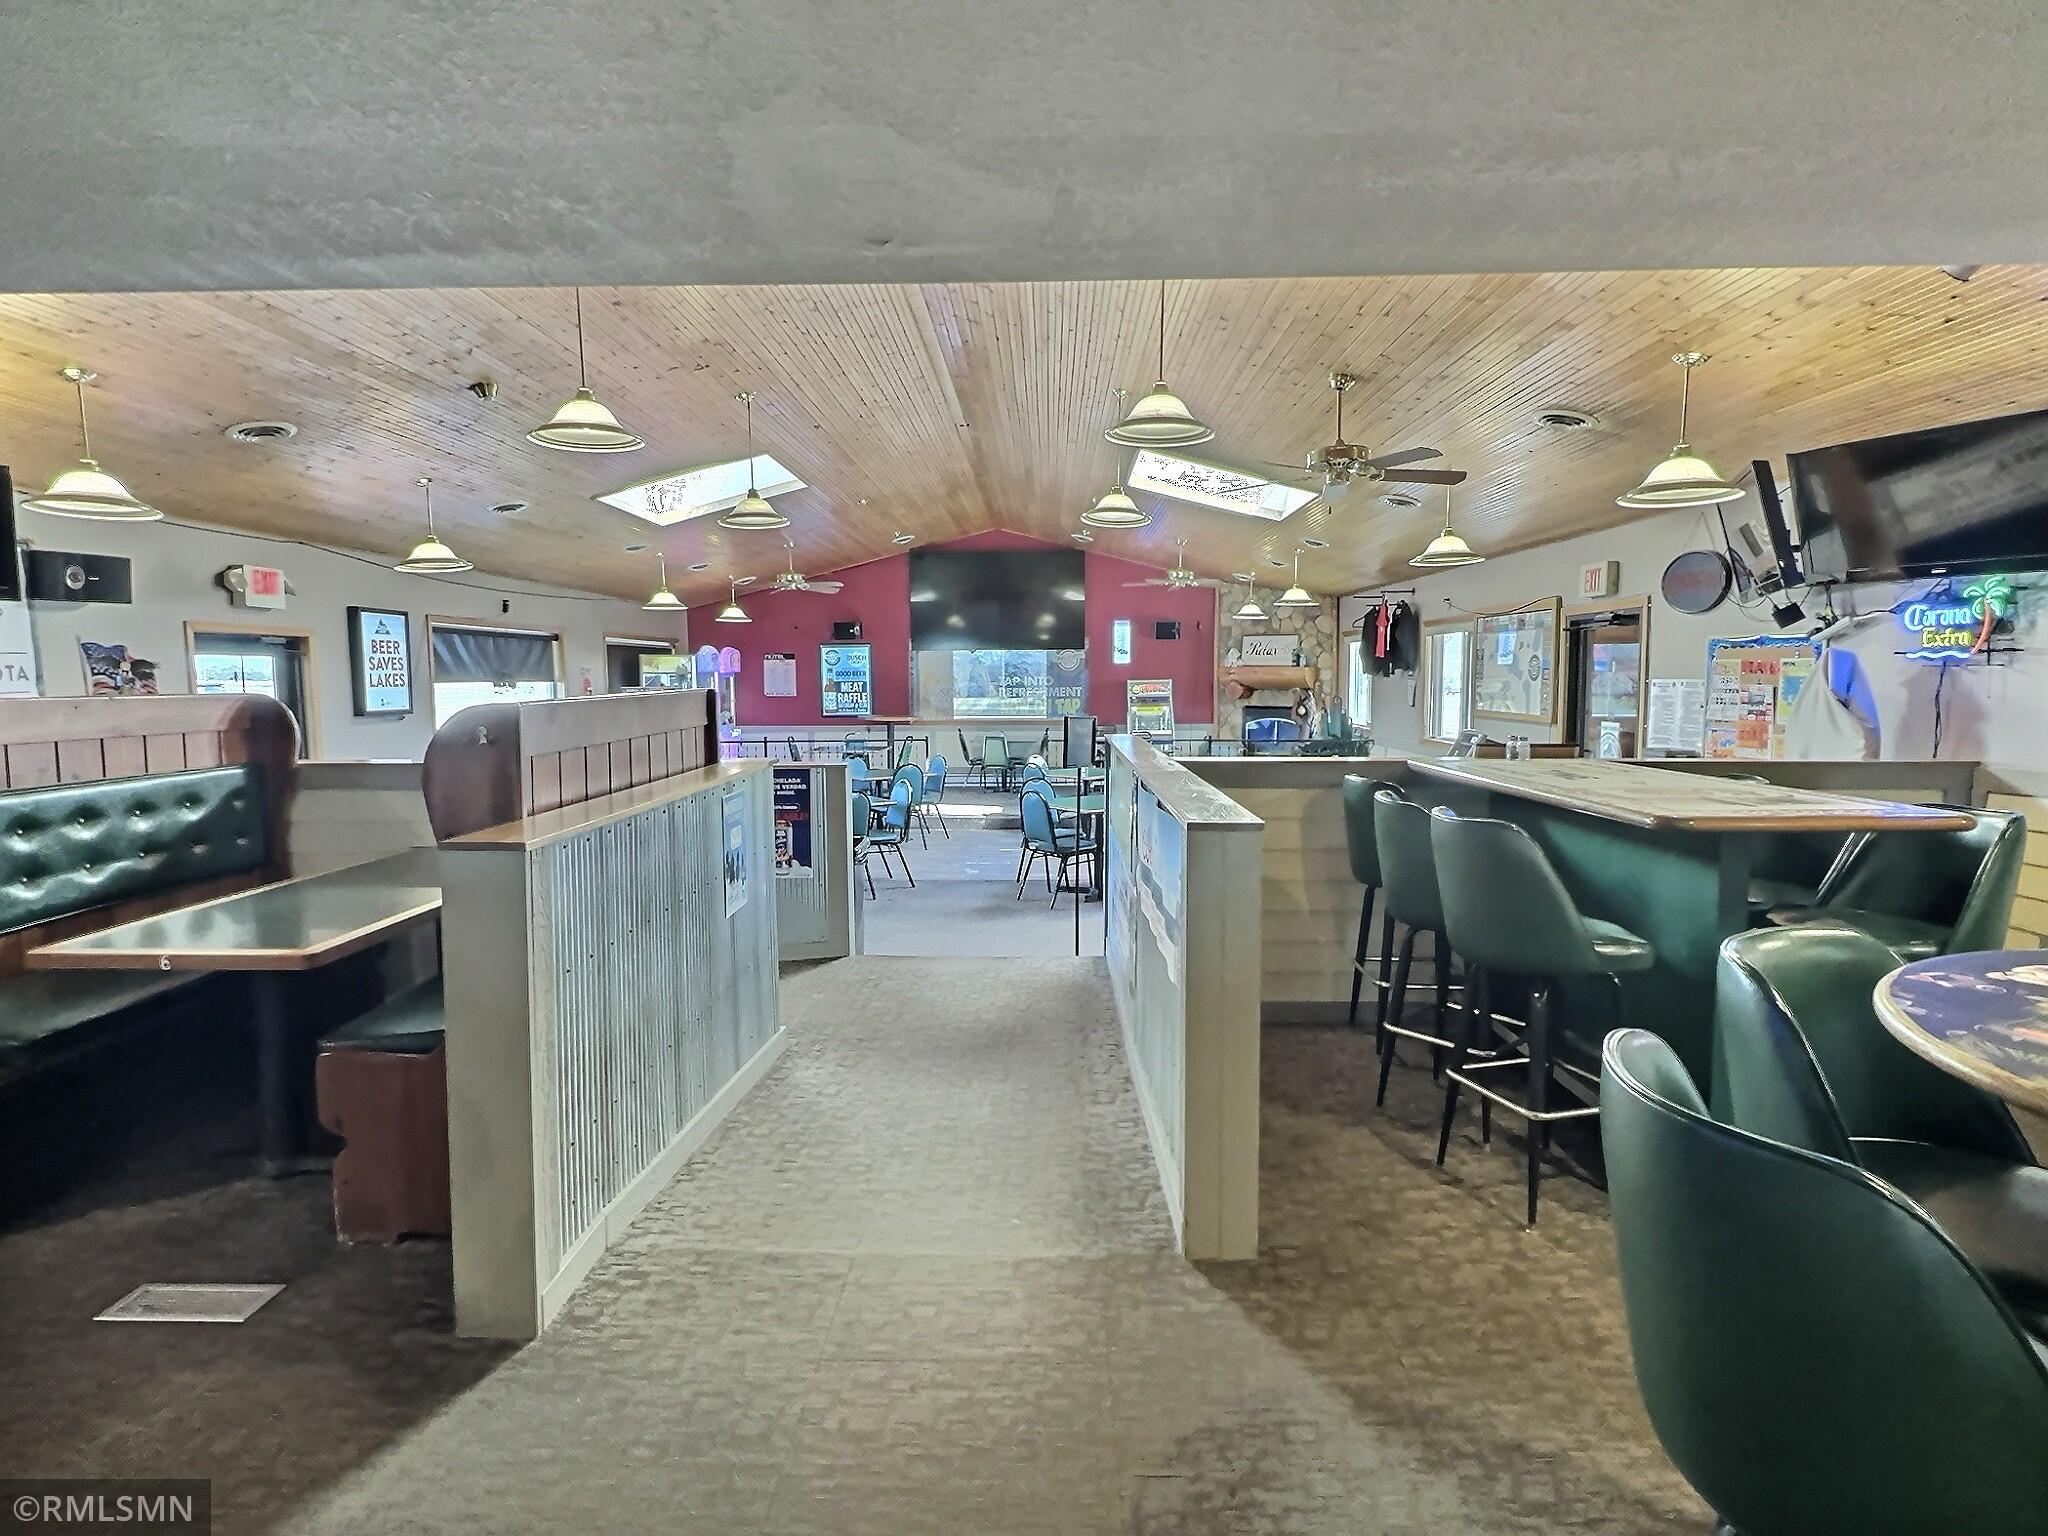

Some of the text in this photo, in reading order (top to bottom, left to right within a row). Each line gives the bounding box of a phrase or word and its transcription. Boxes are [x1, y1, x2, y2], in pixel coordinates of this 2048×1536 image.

[251, 569, 279, 596] EXIT
[1584, 567, 1601, 593] EXIT
[1921, 627, 1973, 648] Extra
[371, 640, 400, 655] BEER
[1246, 640, 1279, 656] Relax
[368, 656, 404, 671] SAVES
[369, 673, 406, 688] LAKES
[840, 681, 863, 692] MEAT
[999, 675, 1054, 686] TAP INTO
[837, 692, 869, 703] RAFFLE
[1056, 699, 1081, 713] TAP
